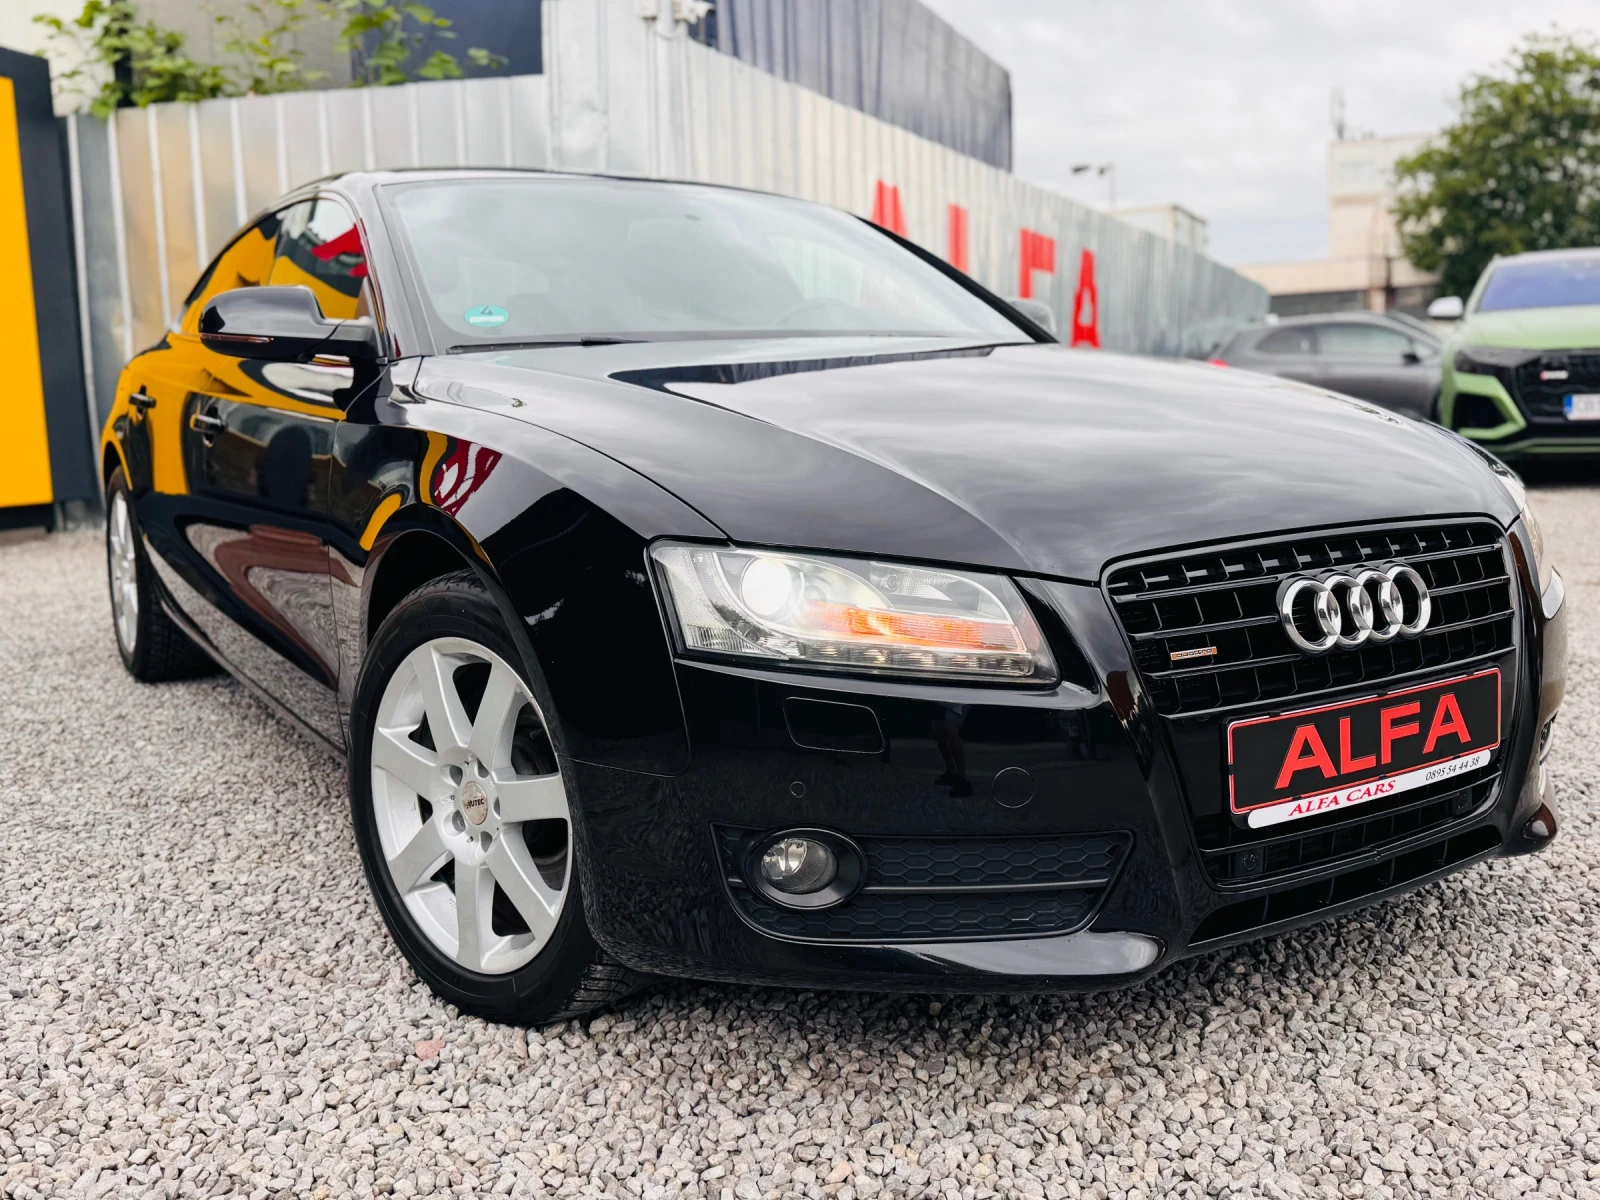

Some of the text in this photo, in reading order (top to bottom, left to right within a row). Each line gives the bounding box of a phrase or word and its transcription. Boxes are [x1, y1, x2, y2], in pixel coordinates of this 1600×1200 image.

[480, 305, 494, 316] 4
[1275, 693, 1471, 789] ALFA
[1425, 757, 1480, 781] 0895 54 44 38
[1288, 780, 1396, 816] ALFA CARS
